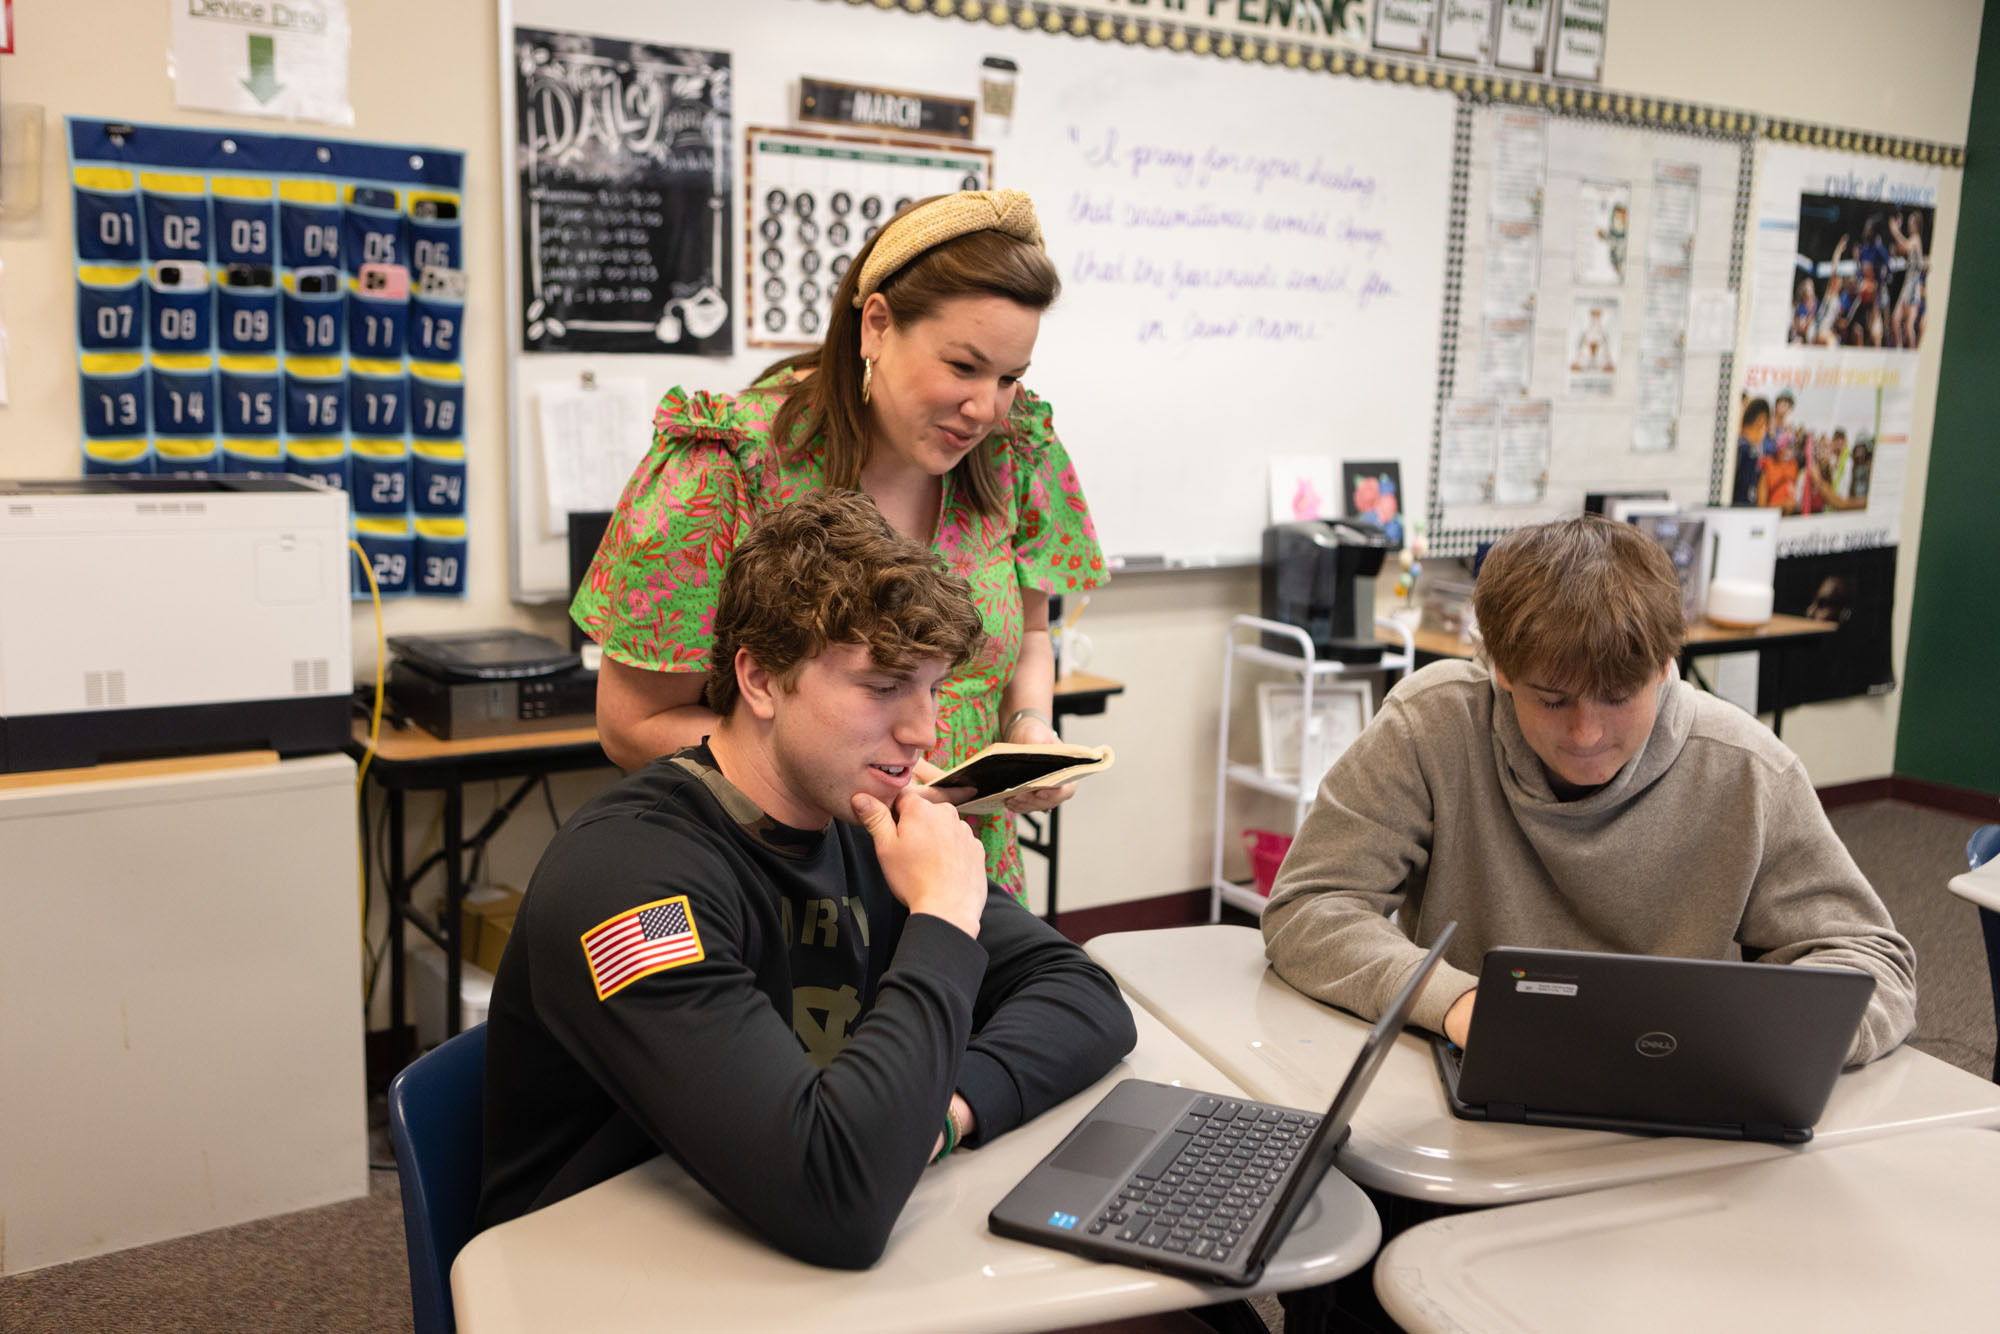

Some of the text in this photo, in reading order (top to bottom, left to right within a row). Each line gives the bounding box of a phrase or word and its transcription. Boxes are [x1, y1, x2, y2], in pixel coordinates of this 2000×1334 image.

[851, 90, 922, 129] MARCH
[100, 212, 448, 265] 01 02 03 04 05 06
[98, 305, 454, 349] 07 08 09 10 11 12
[1746, 367, 1812, 390] group
[102, 391, 455, 430] 13 14 15 16 17 18
[372, 472, 405, 503] 23
[428, 475, 461, 504] 24
[374, 552, 458, 586] 29 30
[1640, 1039, 1674, 1050] DELL
